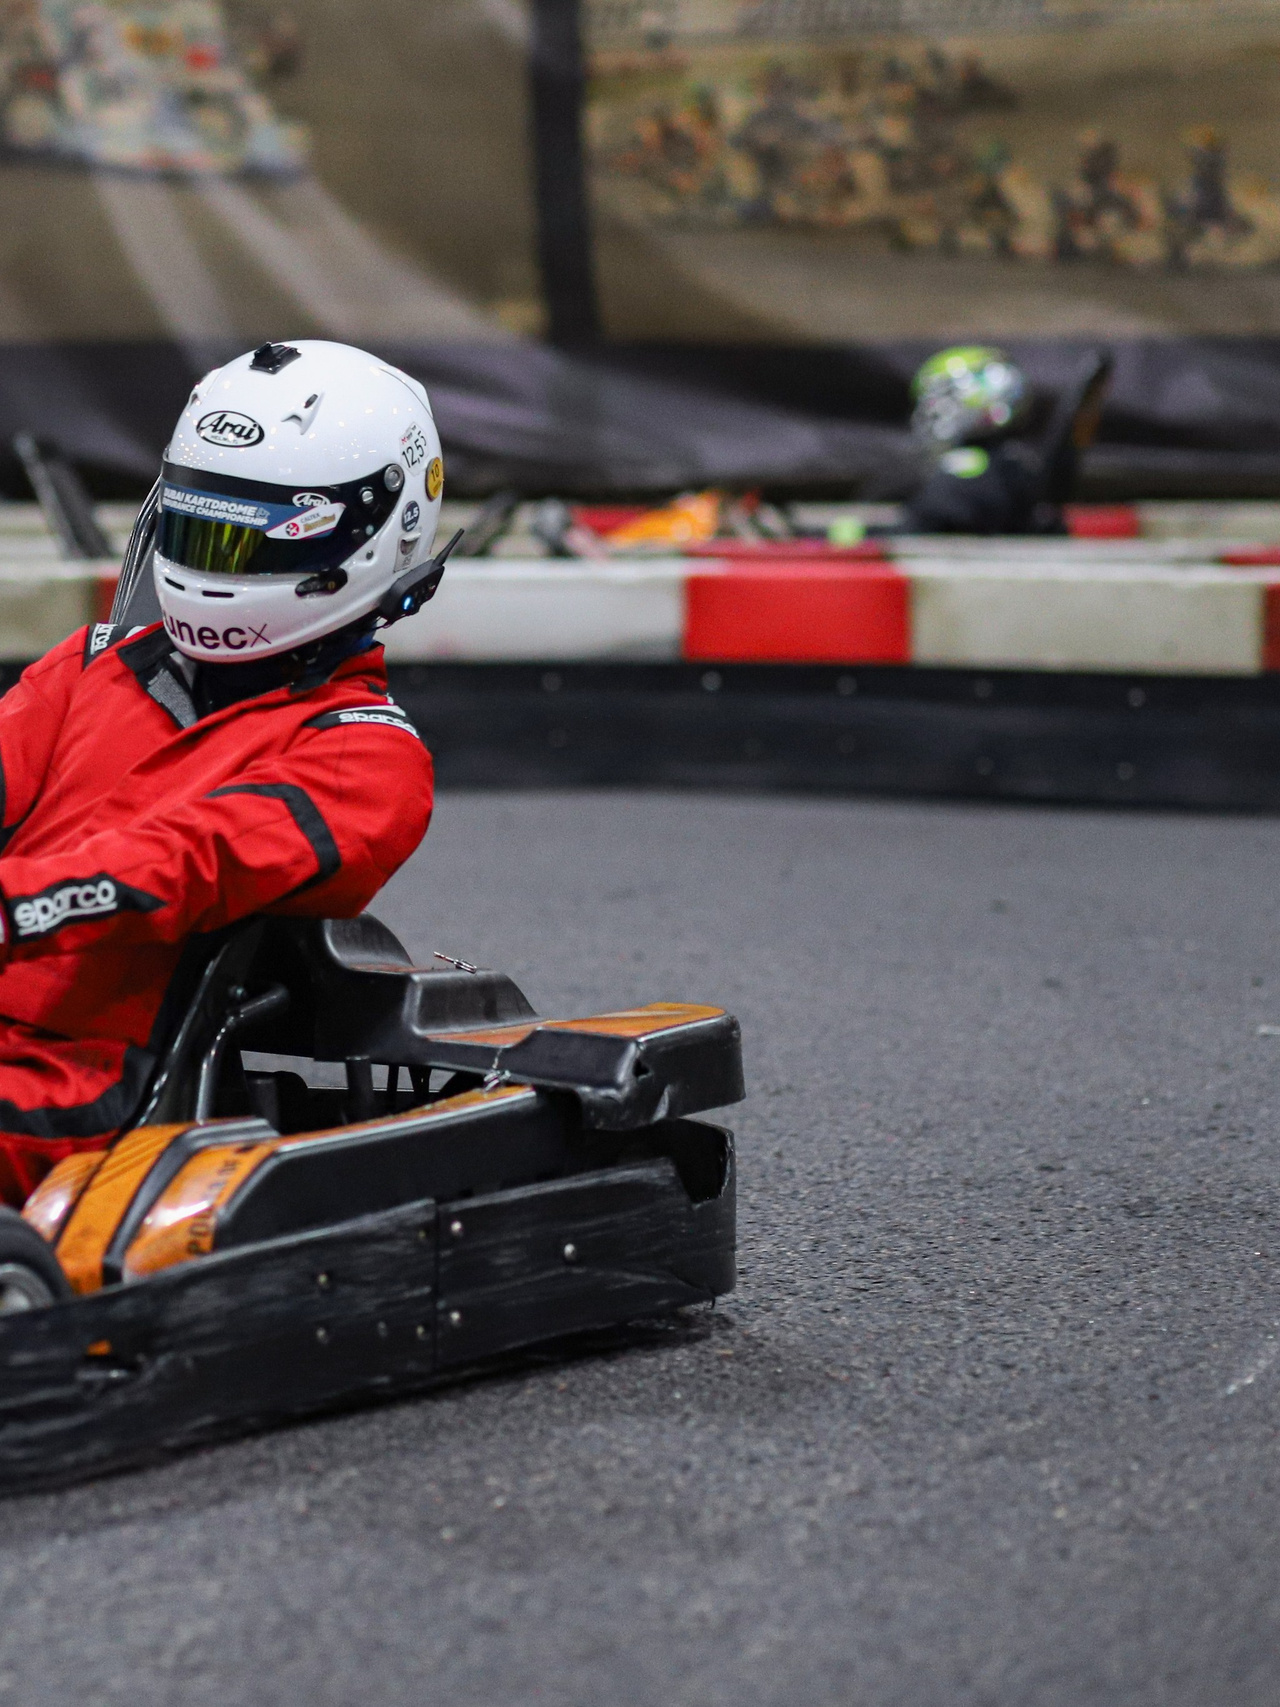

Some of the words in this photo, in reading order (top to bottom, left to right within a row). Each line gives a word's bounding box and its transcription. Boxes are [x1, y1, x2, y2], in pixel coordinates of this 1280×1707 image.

[200, 413, 258, 440] Arai
[431, 463, 440, 482] 10
[184, 493, 258, 517] KARTDROME
[196, 505, 269, 527] CHAMPIONSHIP
[14, 879, 118, 936] sparco
